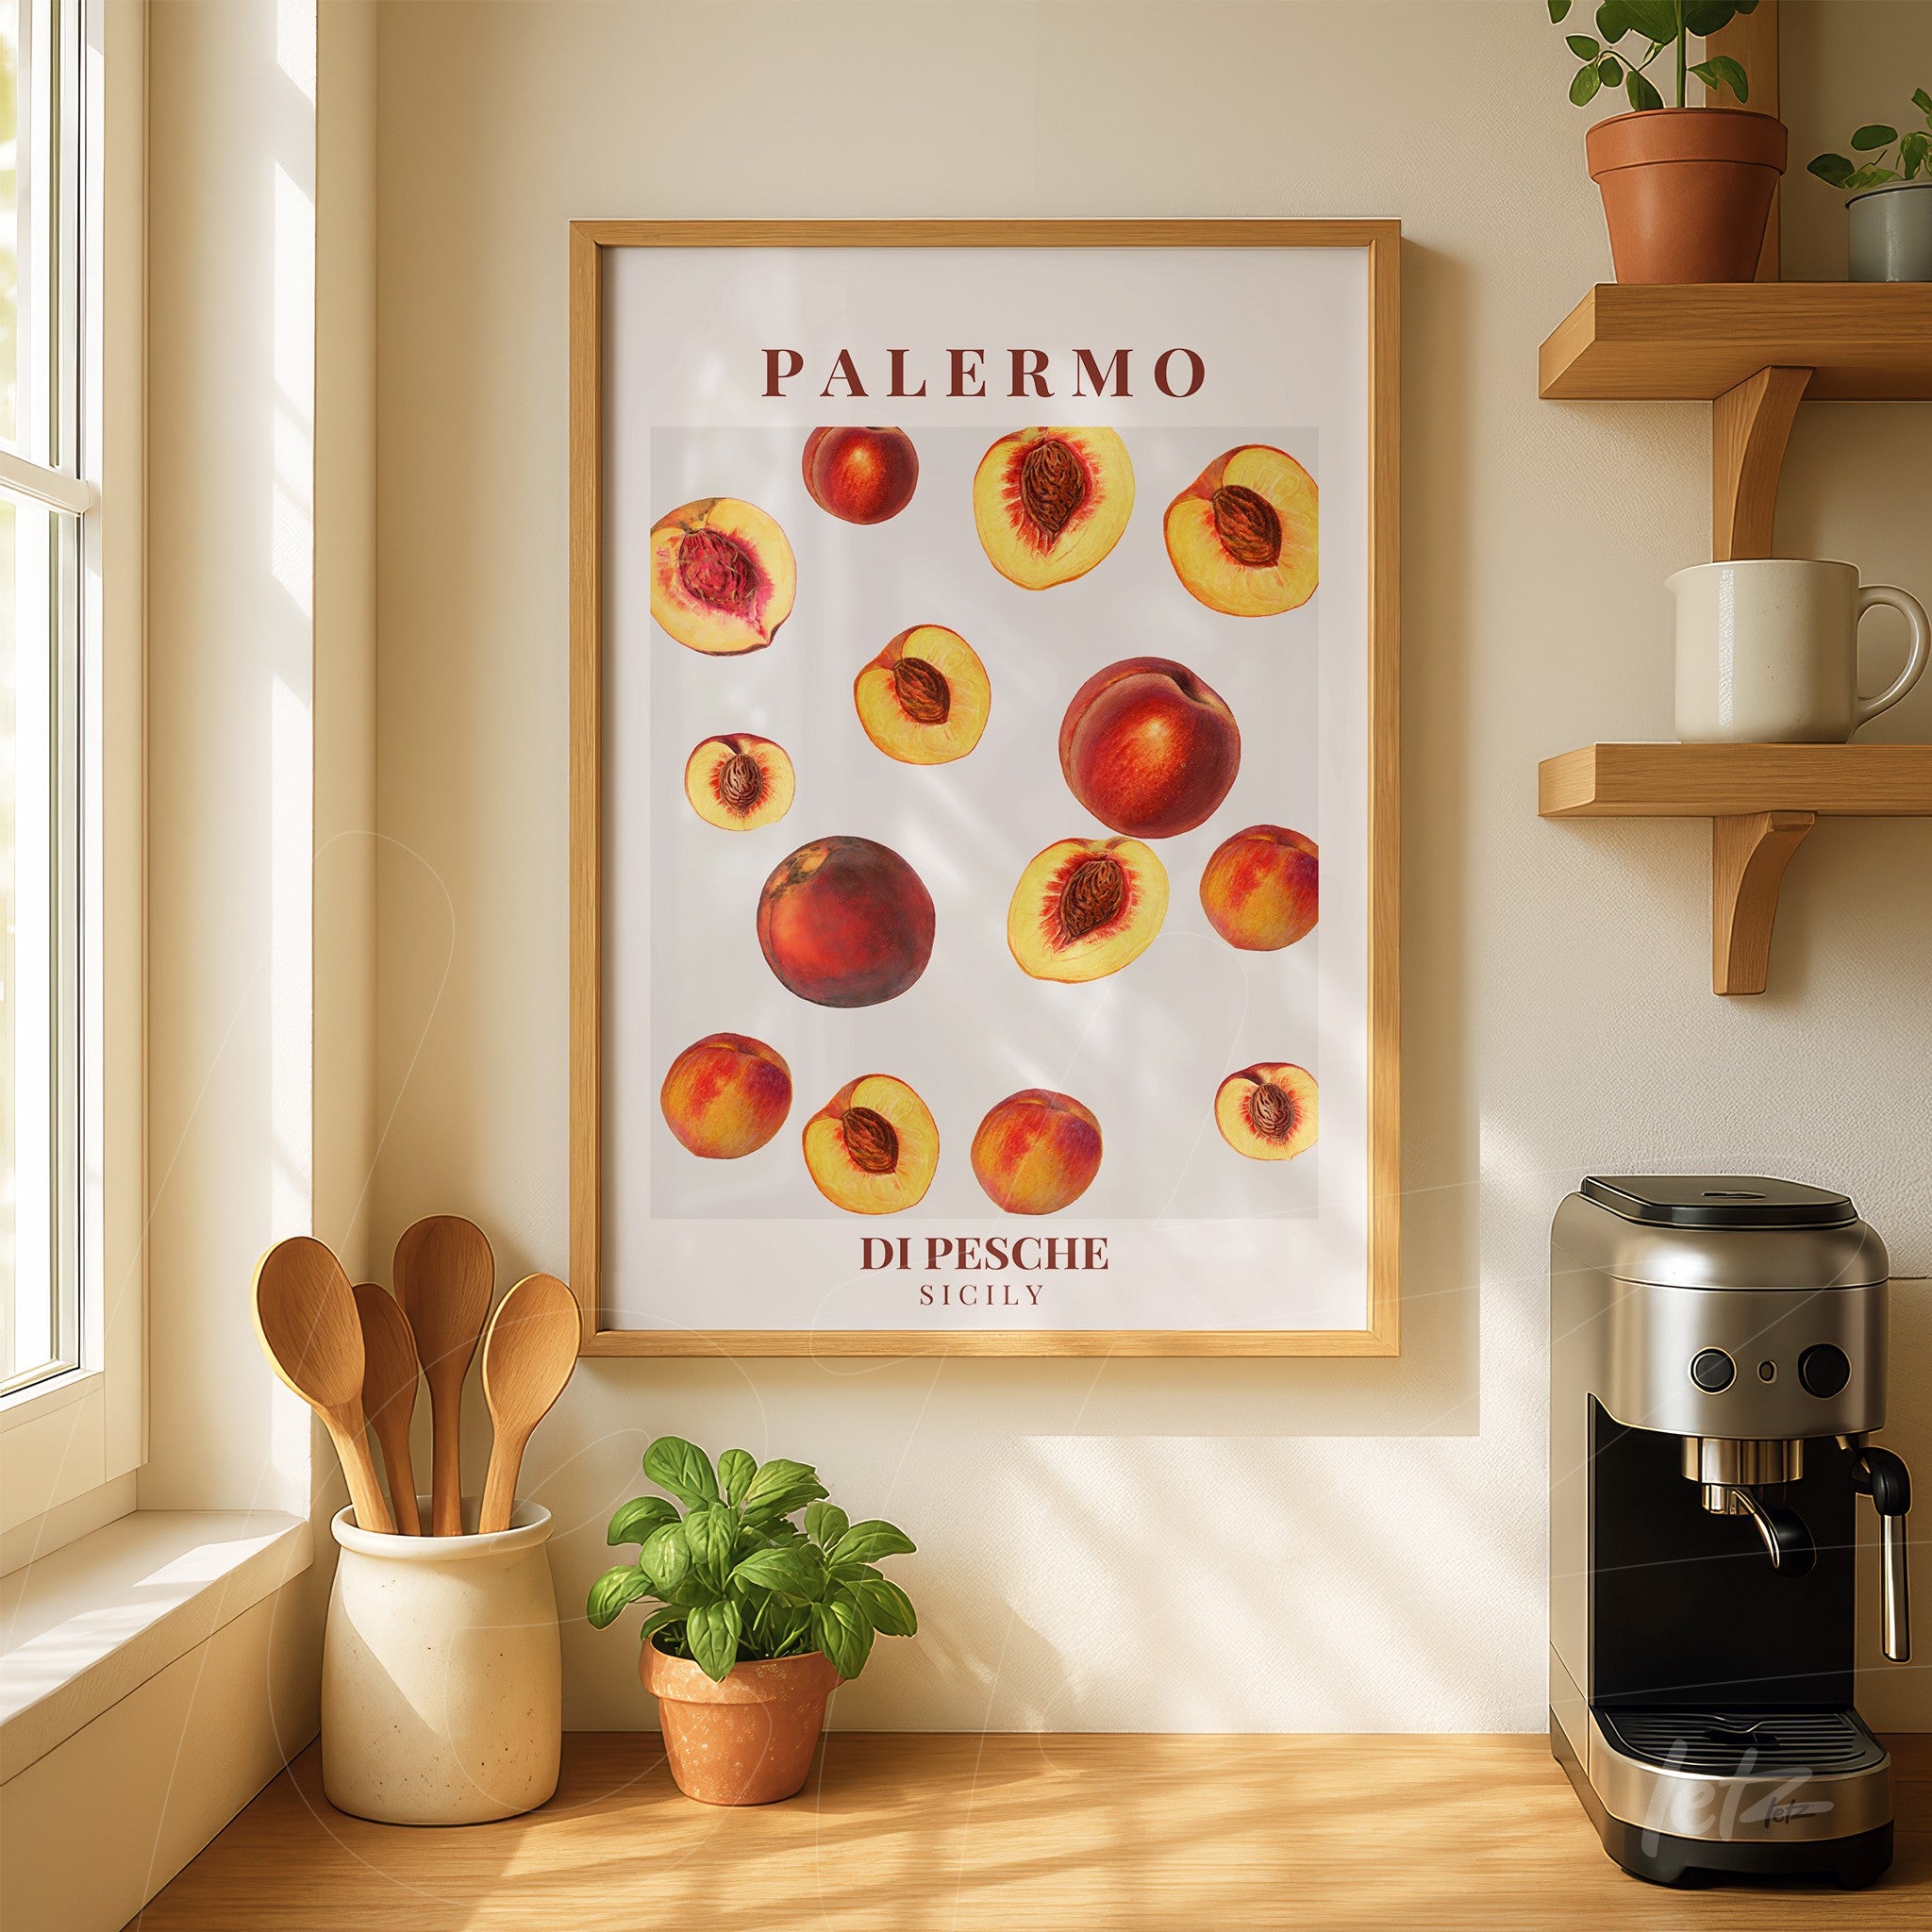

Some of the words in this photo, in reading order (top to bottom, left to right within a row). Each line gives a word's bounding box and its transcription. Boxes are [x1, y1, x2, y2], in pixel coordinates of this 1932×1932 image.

[761, 347, 1206, 398] PALERMO
[859, 1237, 912, 1271] DI
[924, 1236, 1109, 1271] PESCHE
[920, 1284, 1043, 1306] SICILY
